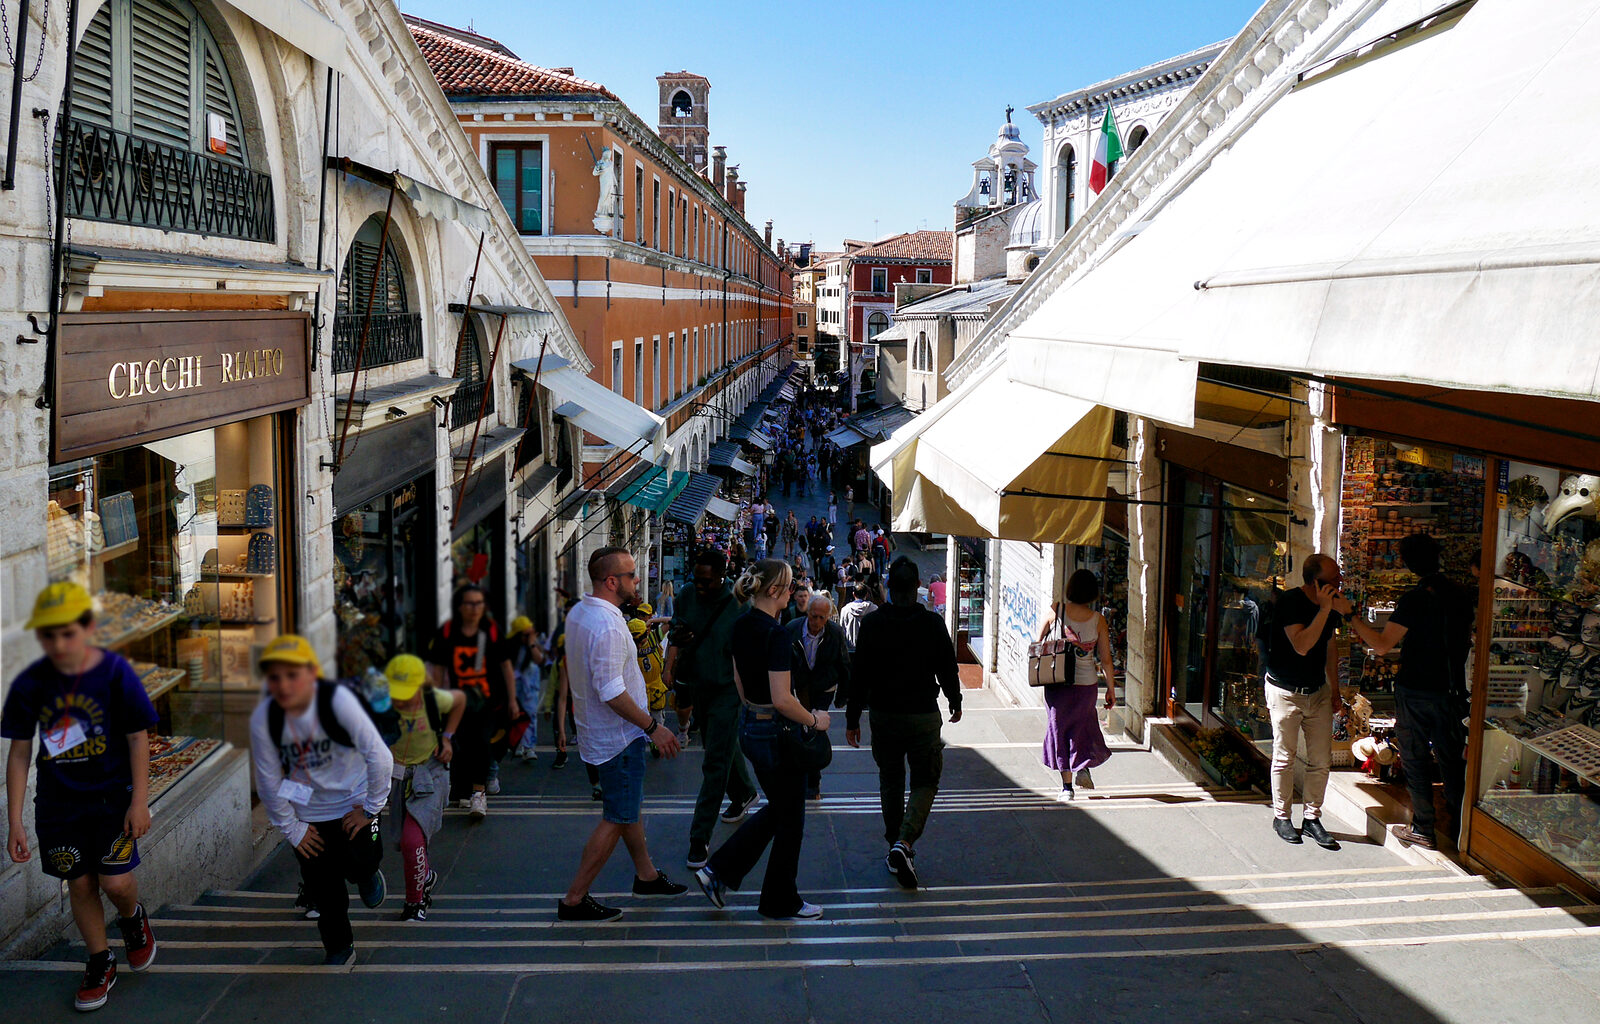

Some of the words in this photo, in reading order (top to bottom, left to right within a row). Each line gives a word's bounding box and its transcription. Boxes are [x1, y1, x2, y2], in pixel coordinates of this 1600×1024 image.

[108, 356, 202, 399] CECCHI
[220, 348, 282, 383] RIALTO
[414, 846, 426, 891] adidas
